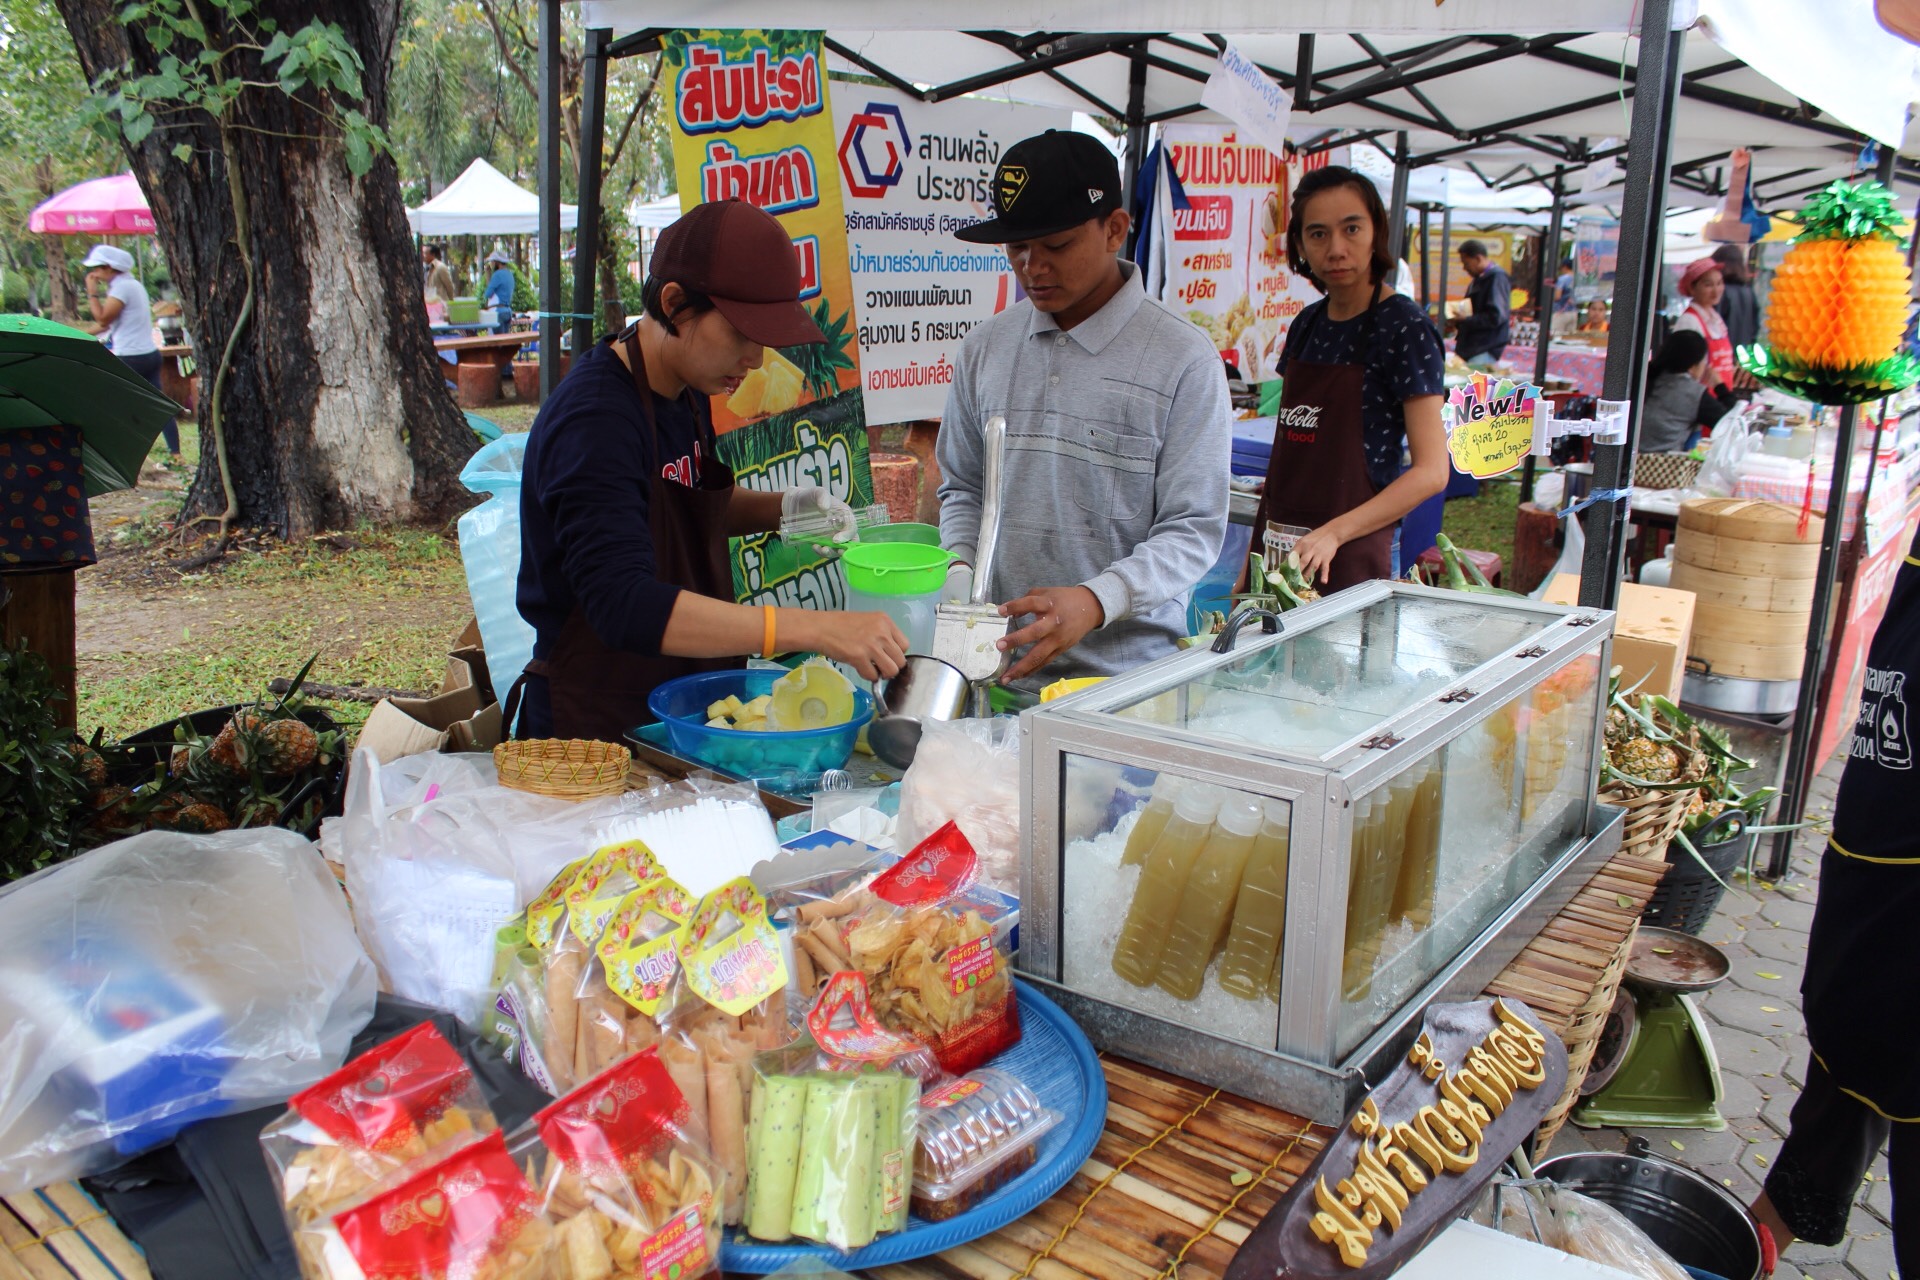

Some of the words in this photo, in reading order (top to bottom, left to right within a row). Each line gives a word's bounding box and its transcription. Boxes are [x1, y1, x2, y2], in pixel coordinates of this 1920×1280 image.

[680, 47, 820, 125] สับปะรด
[919, 130, 999, 164] สานพลัง
[704, 143, 815, 209] บ้านคา
[1174, 203, 1227, 232] ขนมจีบ
[1191, 248, 1233, 271] สาหร่าย
[866, 284, 972, 309] วางแผนพัฒนา
[1185, 277, 1217, 304] ปูอัด
[1263, 271, 1289, 297] หมูสับ
[856, 317, 905, 353] ลุ่มงาน
[911, 320, 921, 343] 5
[1455, 388, 1526, 426] New!
[1287, 429, 1316, 443] food
[1309, 995, 1546, 1268] มะพร้าวน้ำหอม
